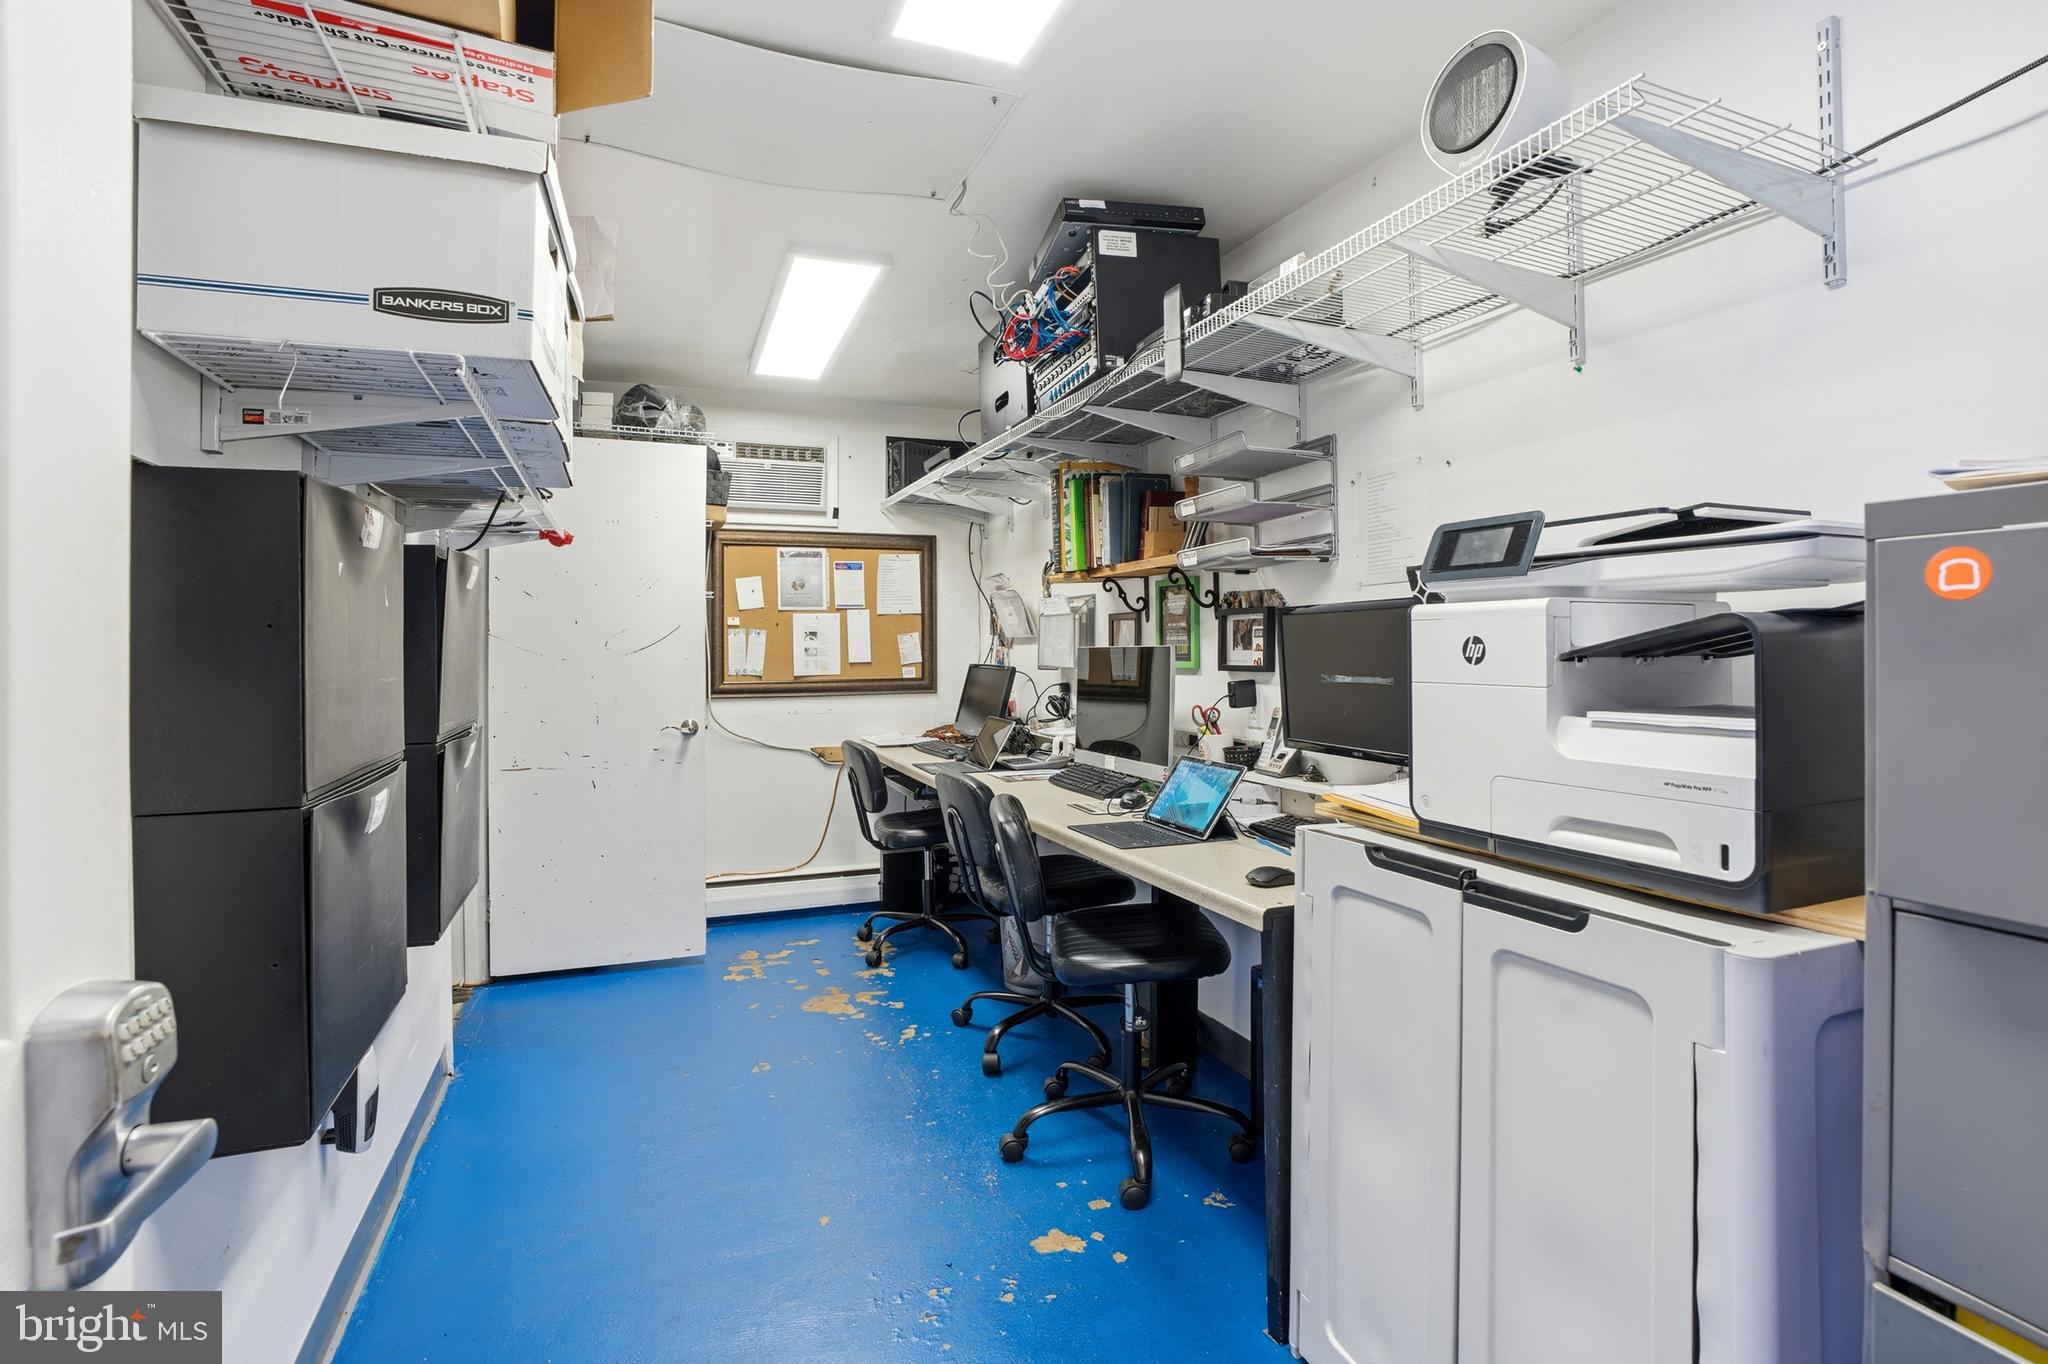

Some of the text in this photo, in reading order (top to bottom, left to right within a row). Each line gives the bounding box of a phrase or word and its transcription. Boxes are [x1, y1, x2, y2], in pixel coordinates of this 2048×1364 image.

[455, 57, 535, 84] 12-Shee
[463, 49, 535, 73] Medium Use
[411, 65, 535, 103] Stapes
[381, 295, 503, 316] BANKERS BOX
[1464, 635, 1484, 665] hp
